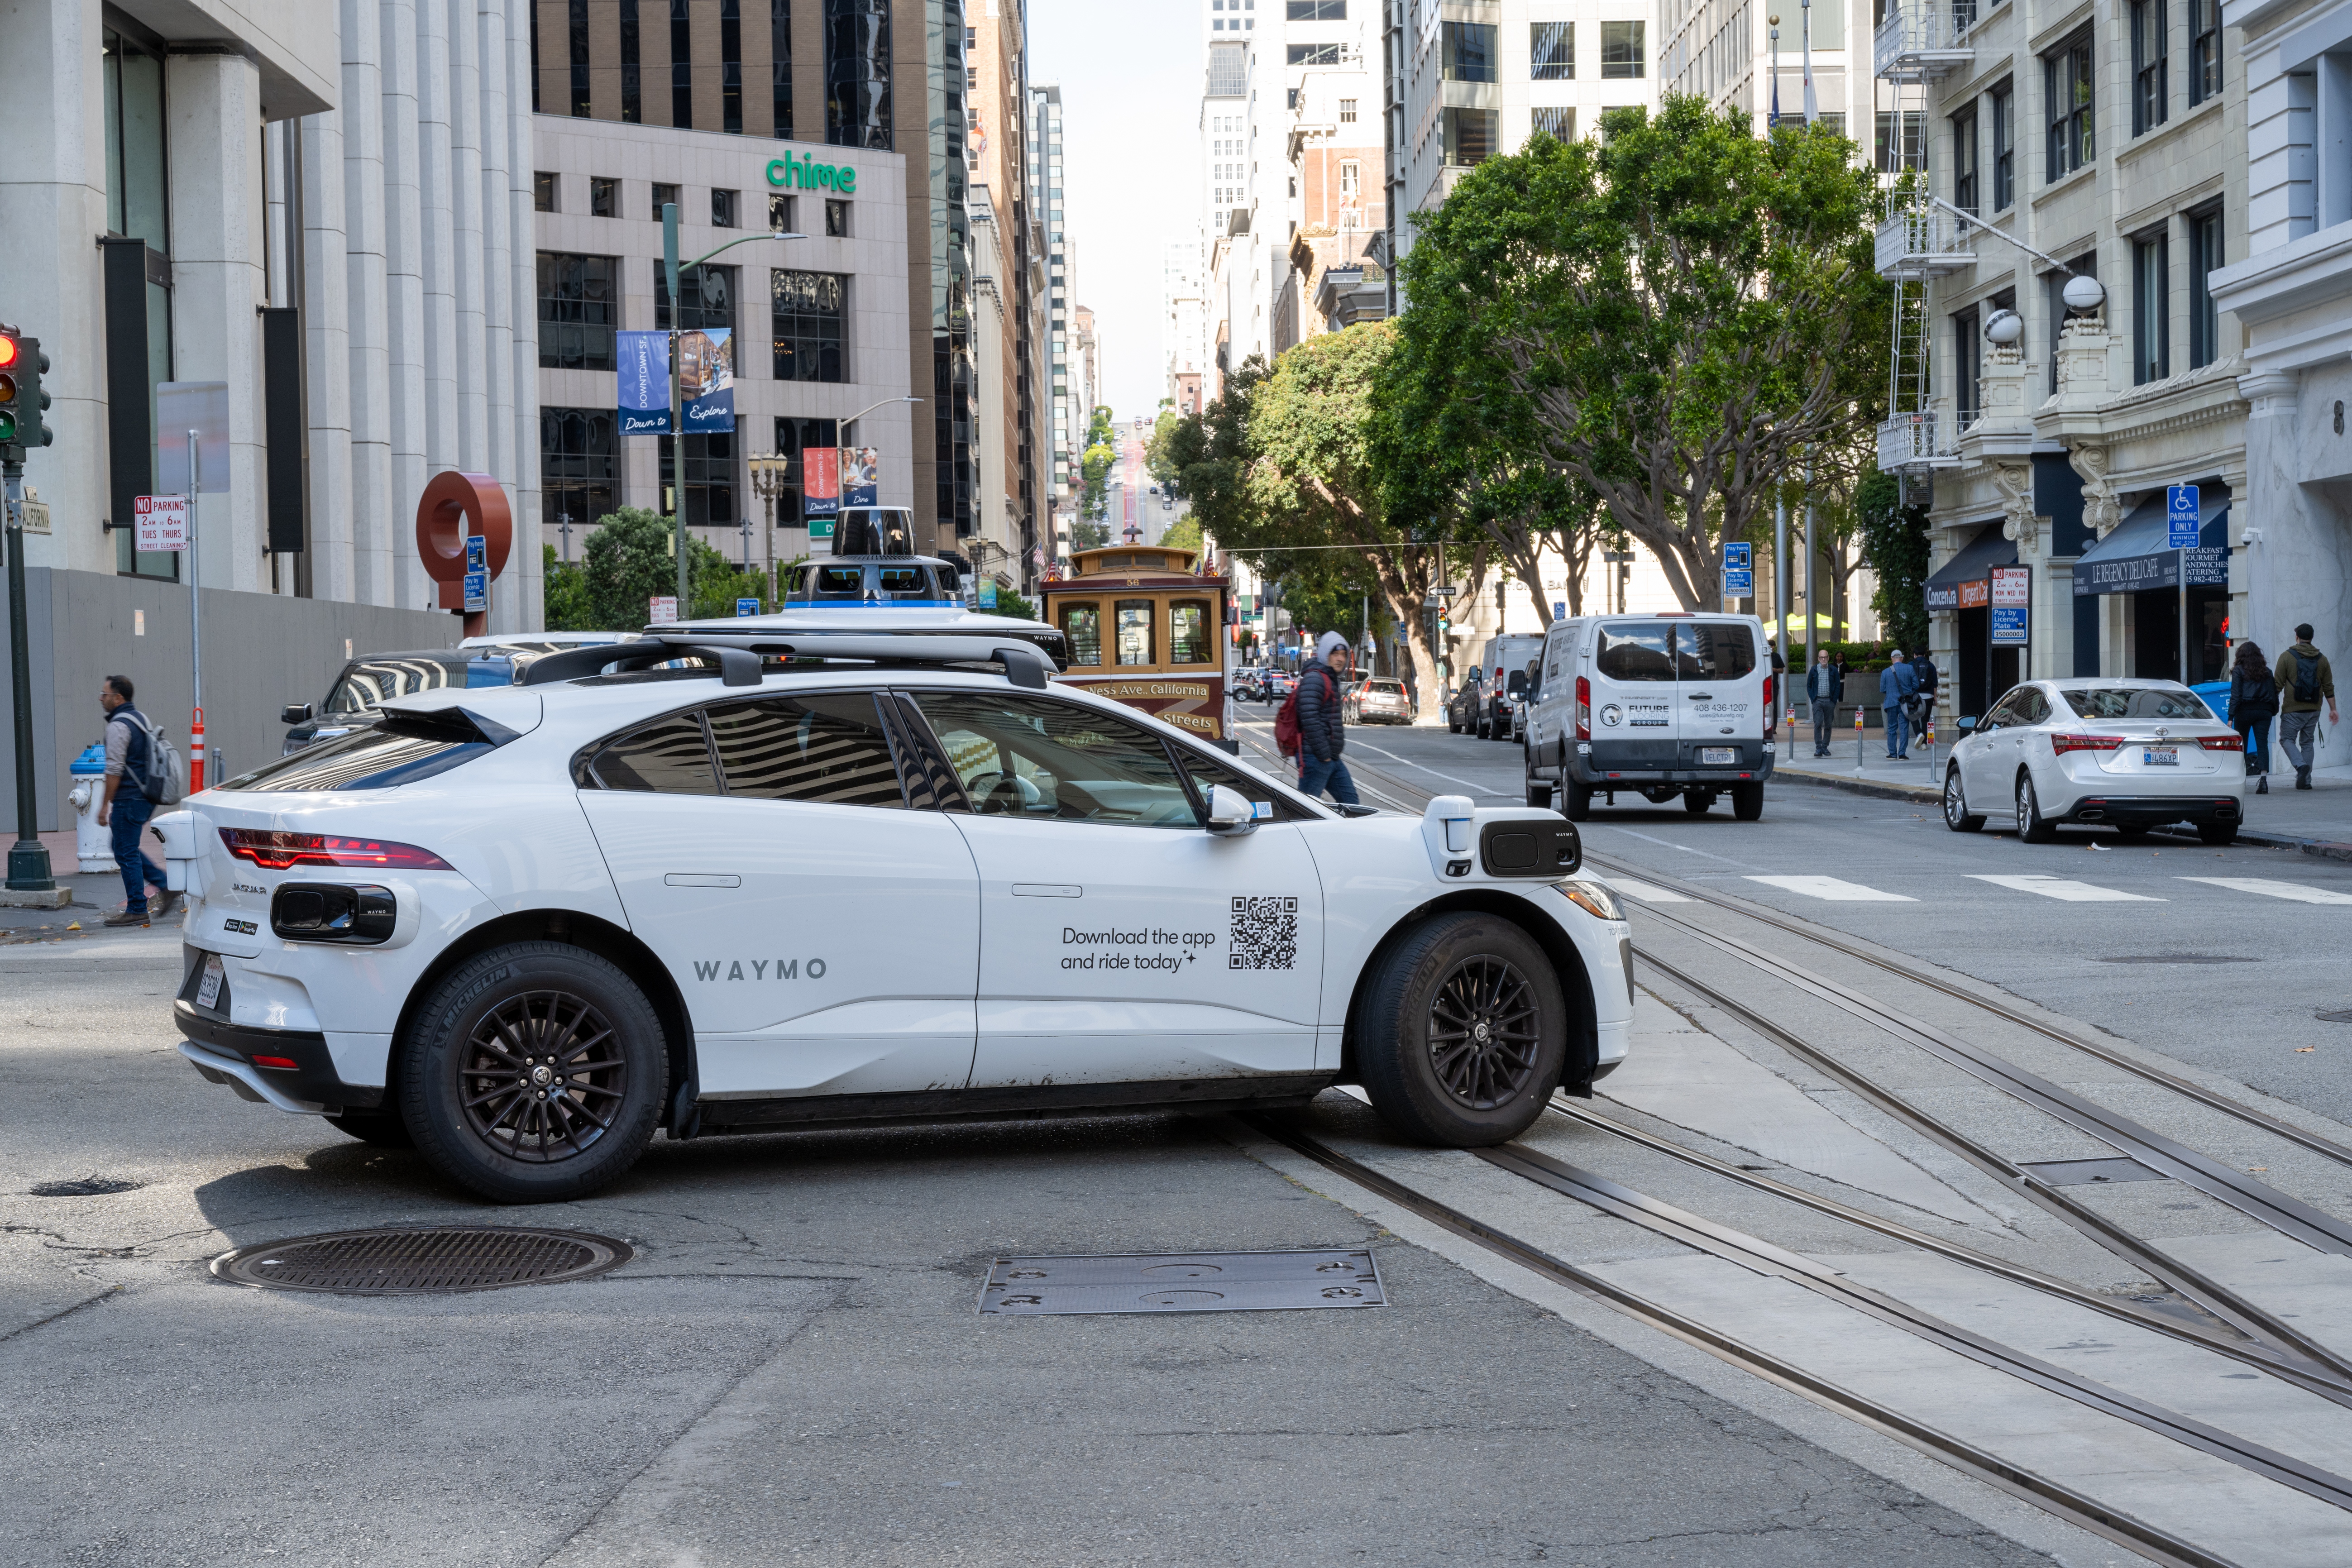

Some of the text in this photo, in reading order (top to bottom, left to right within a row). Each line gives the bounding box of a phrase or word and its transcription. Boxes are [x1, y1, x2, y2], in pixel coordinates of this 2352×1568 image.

[766, 149, 856, 193] chime
[639, 339, 647, 408] DOWNTOWN SF
[689, 405, 727, 420] Explore
[625, 417, 666, 430] Down to
[137, 498, 184, 512] NO PARKING
[853, 496, 869, 504] Dine
[809, 503, 829, 511] Down
[23, 507, 50, 528] ALIFORNIA
[2170, 512, 2198, 521] PARKING
[2175, 522, 2192, 531] ONLY
[142, 529, 182, 539] TUES THURS
[1993, 569, 2003, 578] NO
[2093, 558, 2158, 583] LE REGENCY DELI CAFE
[2164, 565, 2177, 575] BREAKFAST
[1127, 578, 1140, 587] 56
[2165, 575, 2177, 584] CATERING
[1927, 581, 1988, 607] Concentra Urgent Car
[1994, 609, 2017, 617] Pay by
[1088, 686, 1116, 696] Ness
[1150, 684, 1207, 697] California
[1163, 713, 1211, 728] Streets
[232, 883, 267, 895] JAGUAR
[1063, 927, 1216, 949] Download the app
[1608, 927, 1617, 936] TCP
[693, 958, 827, 981] WAYMO
[1061, 952, 1183, 974] and ride today
[199, 973, 220, 1000] 05352B4
[442, 966, 508, 1031] MICHELIN
